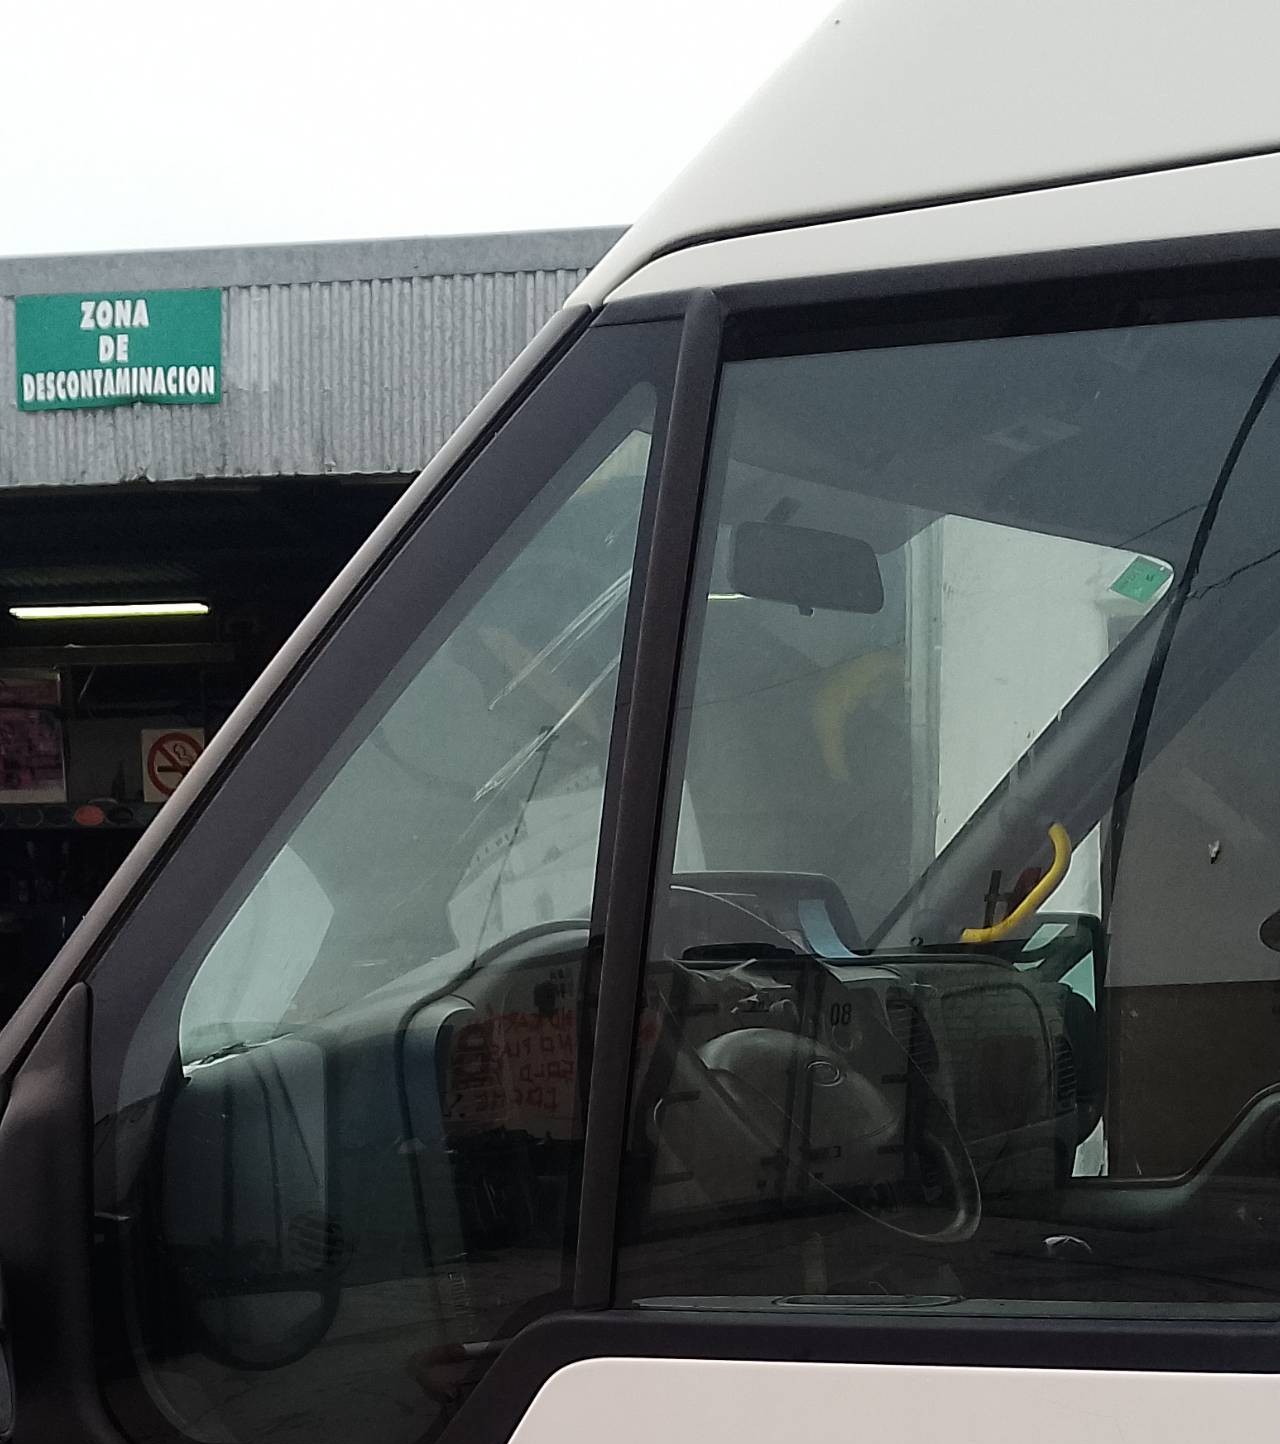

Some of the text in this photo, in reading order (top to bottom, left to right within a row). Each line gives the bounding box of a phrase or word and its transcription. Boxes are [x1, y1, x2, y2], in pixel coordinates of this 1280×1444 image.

[79, 299, 149, 330] ZONA
[99, 334, 129, 363] DE
[22, 366, 215, 401] DESCONTAMINACION
